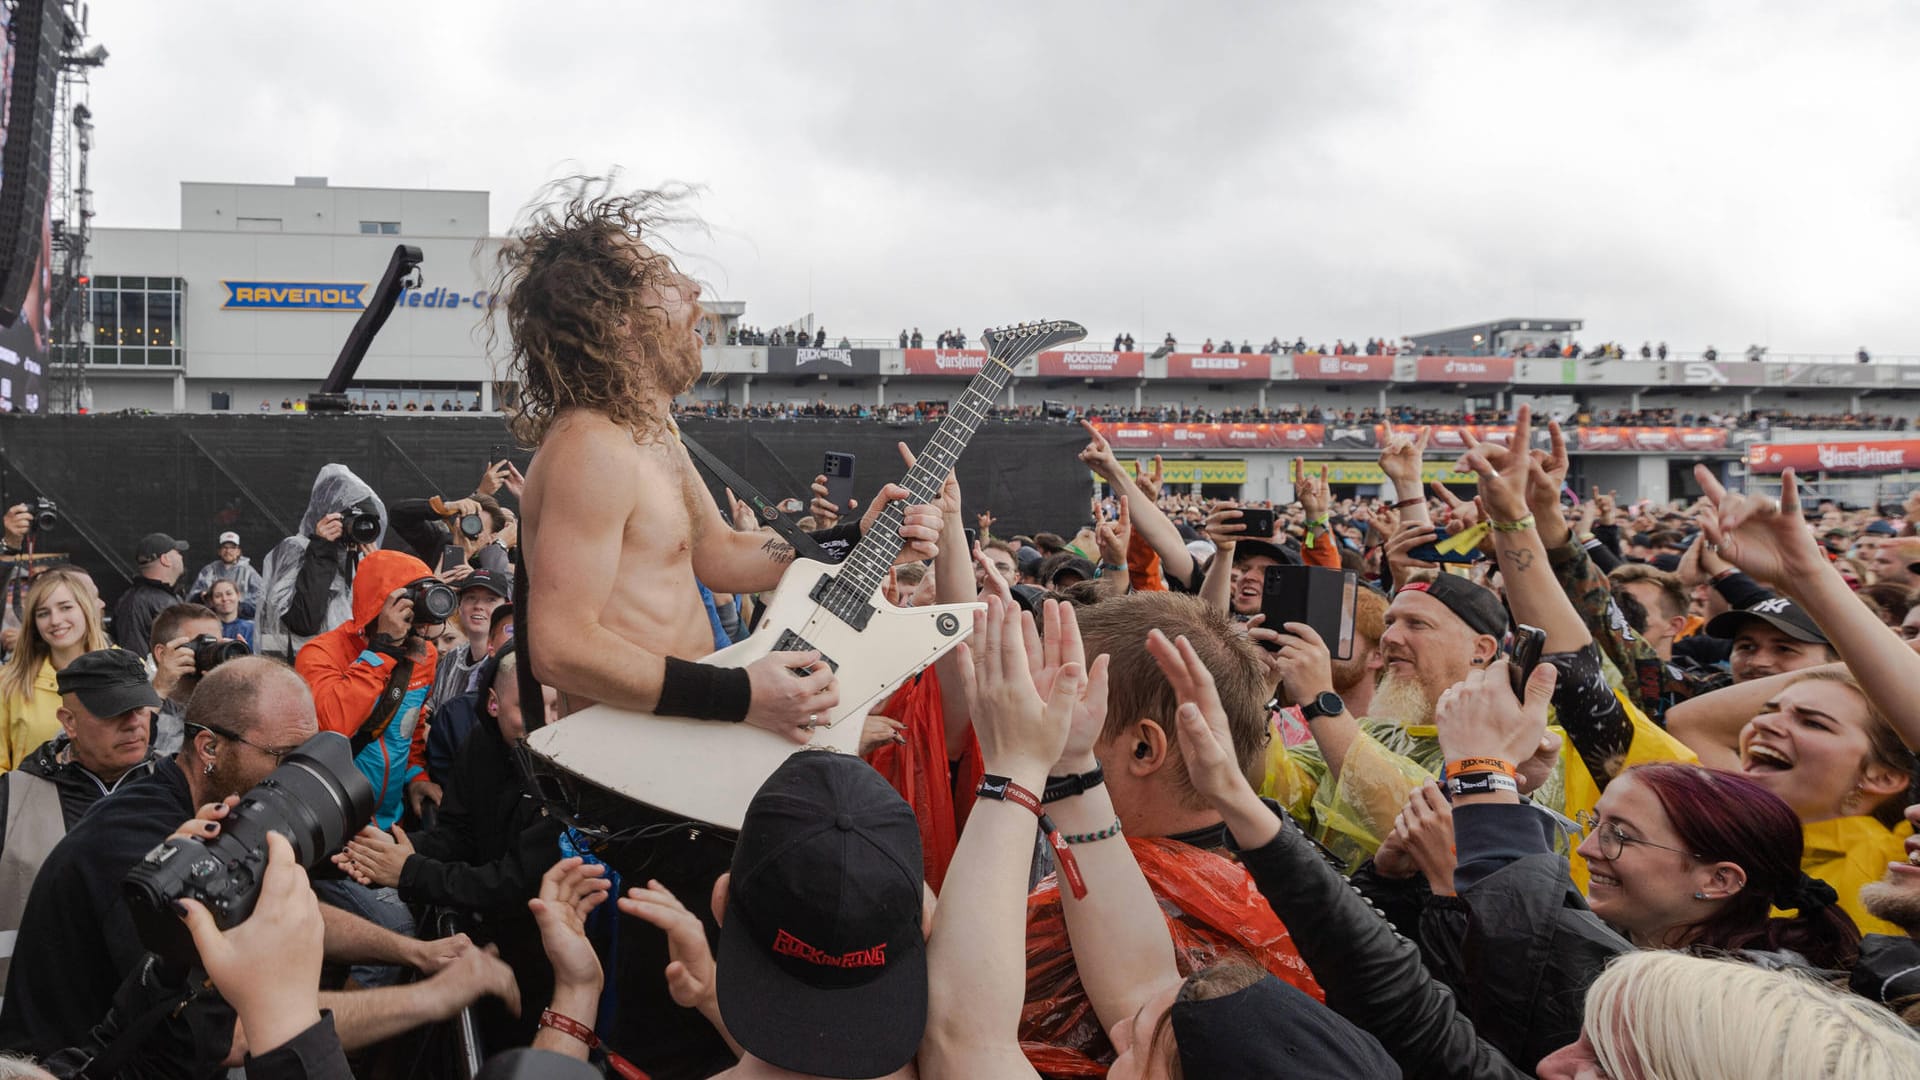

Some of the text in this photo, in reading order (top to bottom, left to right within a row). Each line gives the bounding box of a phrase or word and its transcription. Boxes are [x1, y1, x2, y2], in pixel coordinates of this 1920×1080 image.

[236, 287, 356, 304] RAVENOL
[796, 348, 821, 366] ROCK
[828, 348, 852, 367] RING
[1063, 352, 1119, 364] ROCKSTAR
[773, 928, 824, 965] ROCK
[841, 942, 887, 968] RING
